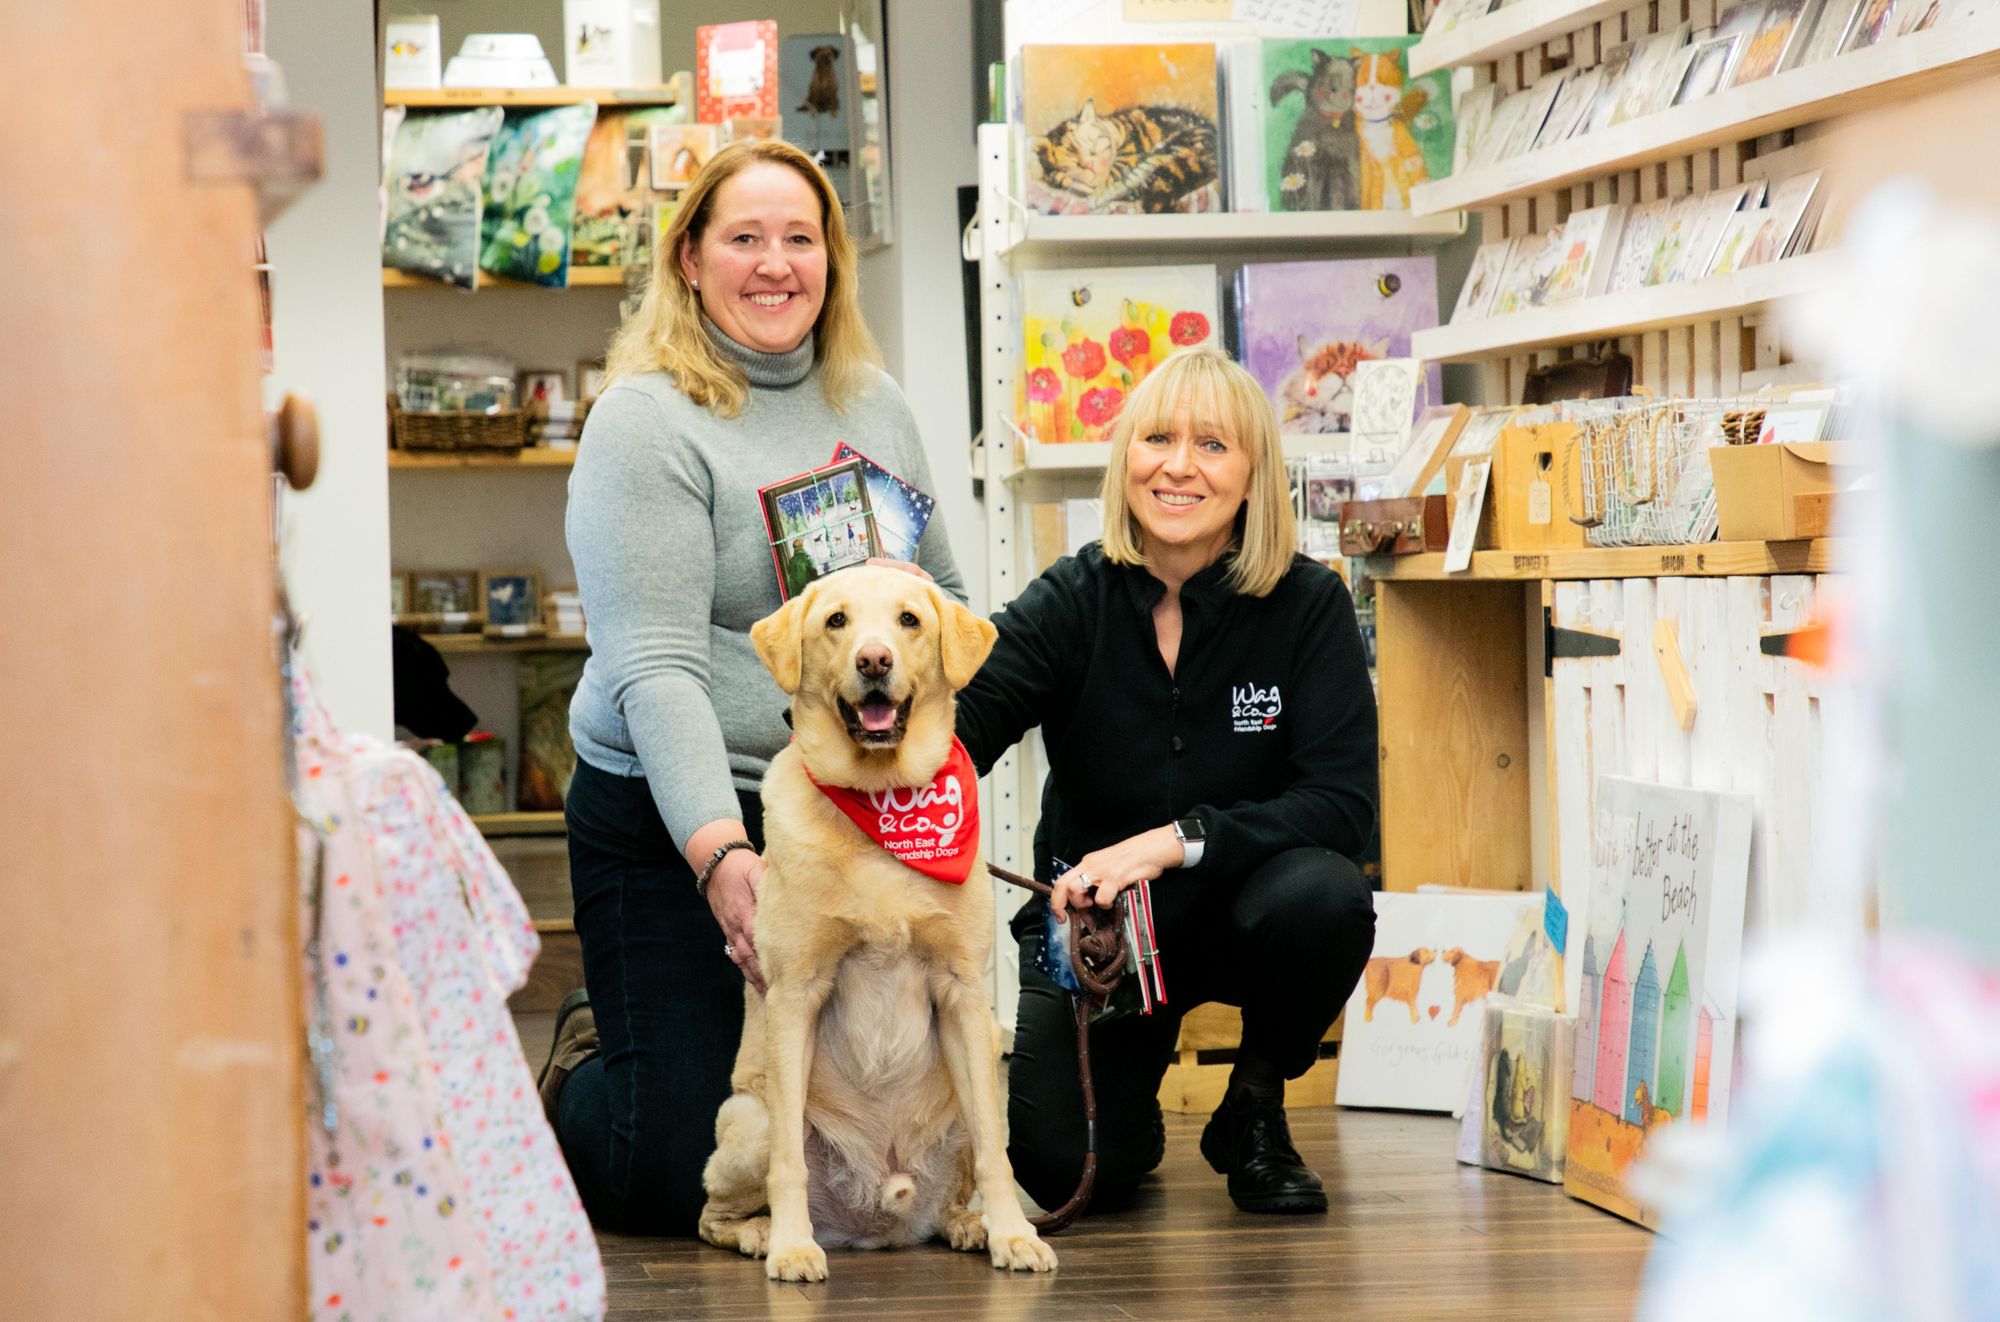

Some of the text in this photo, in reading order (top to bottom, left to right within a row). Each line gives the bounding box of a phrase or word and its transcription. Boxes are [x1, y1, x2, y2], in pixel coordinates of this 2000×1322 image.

[1232, 705, 1241, 718] &
[1233, 681, 1281, 717] Wag
[868, 775, 963, 834] Wag
[879, 813, 897, 834] &
[884, 837, 936, 850] North East
[935, 847, 959, 858] Dogs
[1632, 810, 1663, 879] better
[1666, 815, 1678, 856] at
[1682, 813, 1699, 862] the
[1662, 869, 1697, 926] Beach
